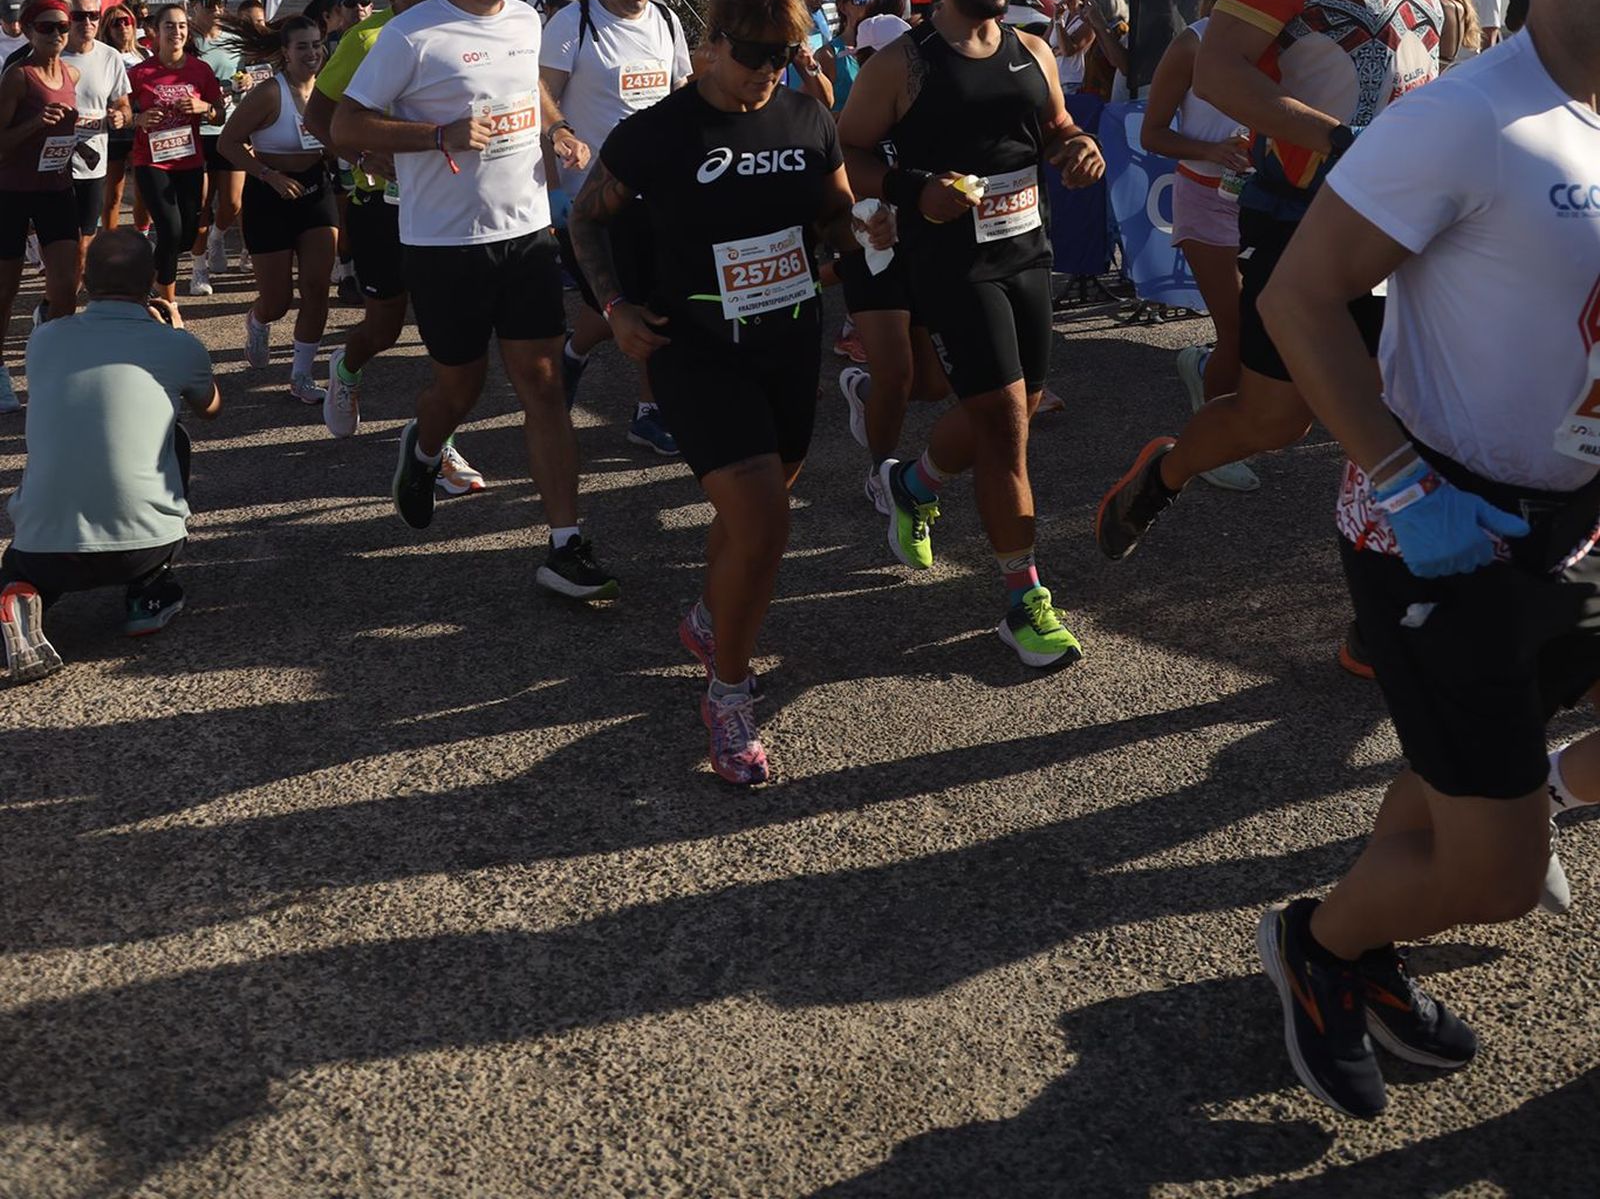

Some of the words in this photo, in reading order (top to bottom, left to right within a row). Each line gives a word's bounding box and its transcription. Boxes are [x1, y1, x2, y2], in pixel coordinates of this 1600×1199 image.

[625, 73, 665, 88] 24372
[46, 146, 69, 158] 243
[983, 188, 1035, 216] 24388
[730, 252, 801, 288] 25786
